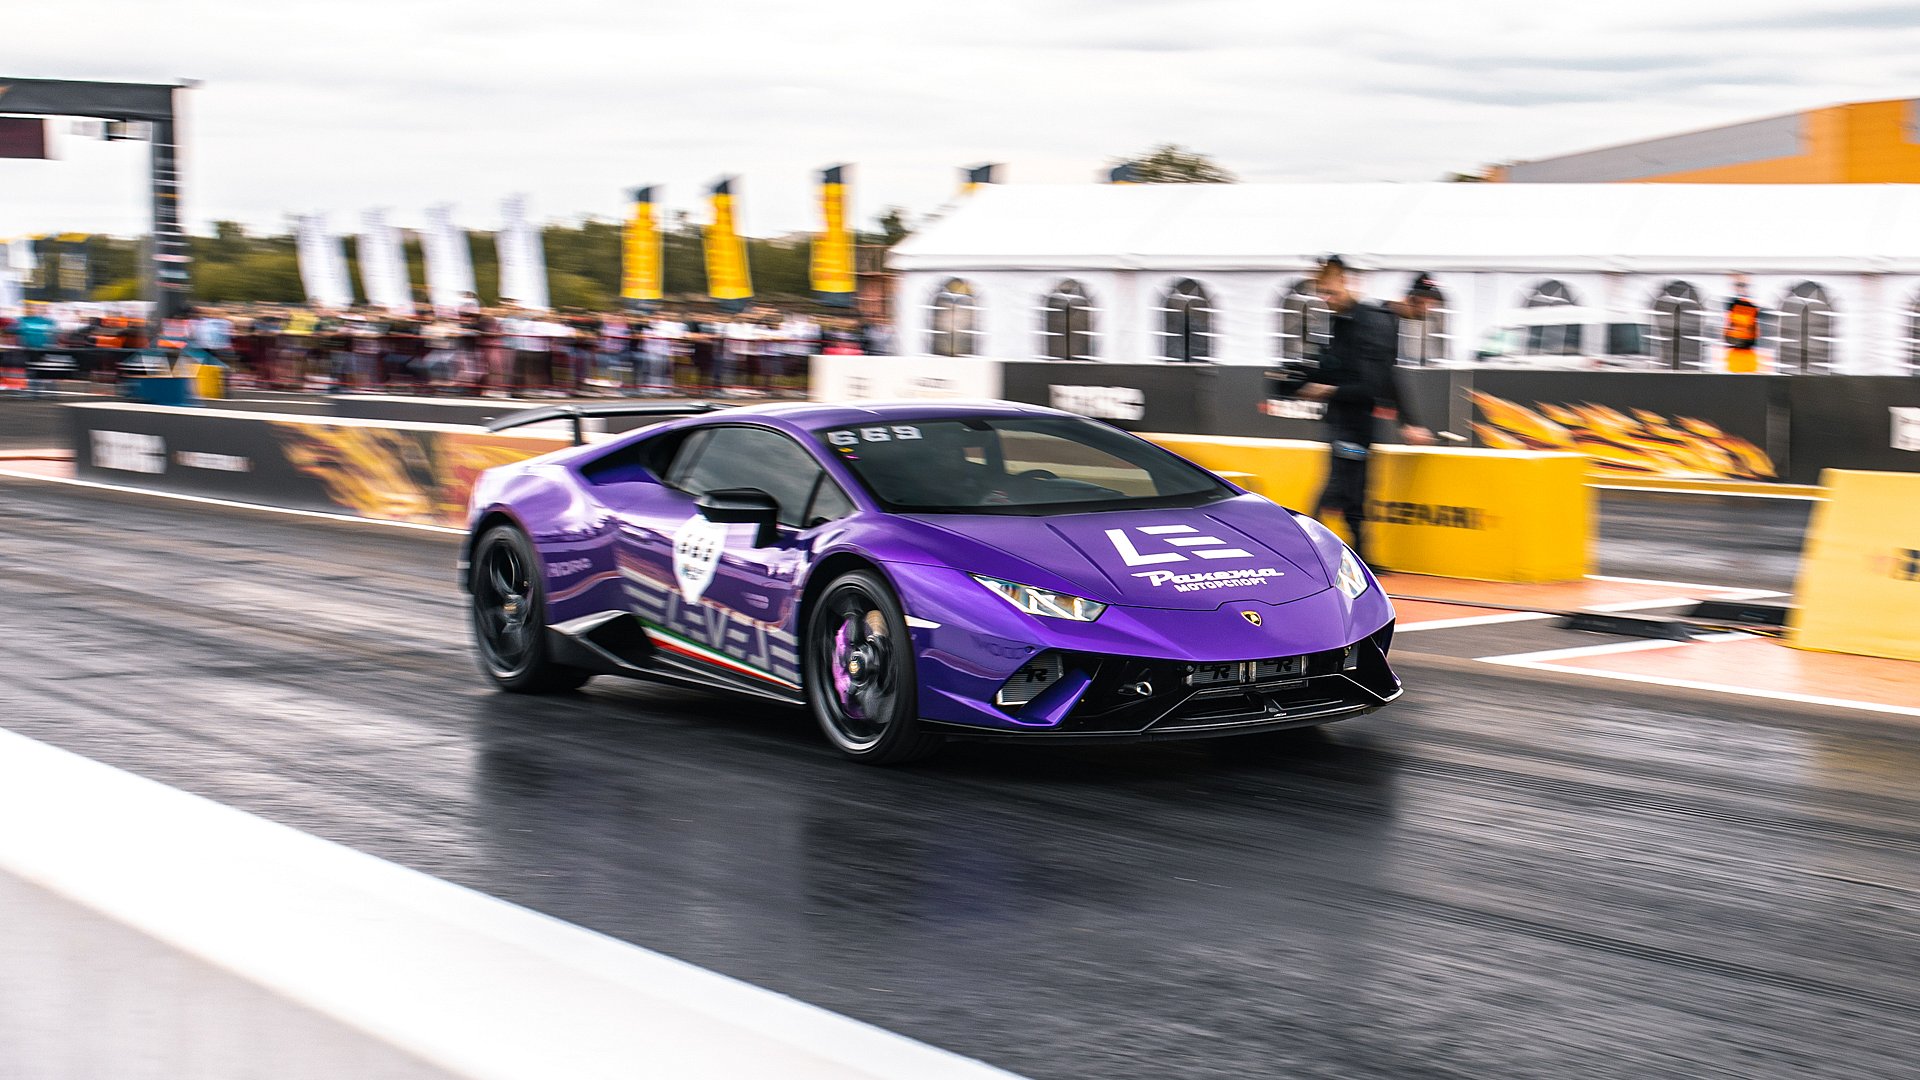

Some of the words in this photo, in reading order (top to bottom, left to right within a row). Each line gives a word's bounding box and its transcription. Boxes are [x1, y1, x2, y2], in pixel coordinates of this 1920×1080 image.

[827, 426, 923, 446] 669
[1130, 568, 1285, 587] Ракета
[1173, 577, 1268, 593] МОТОРСПОРТ
